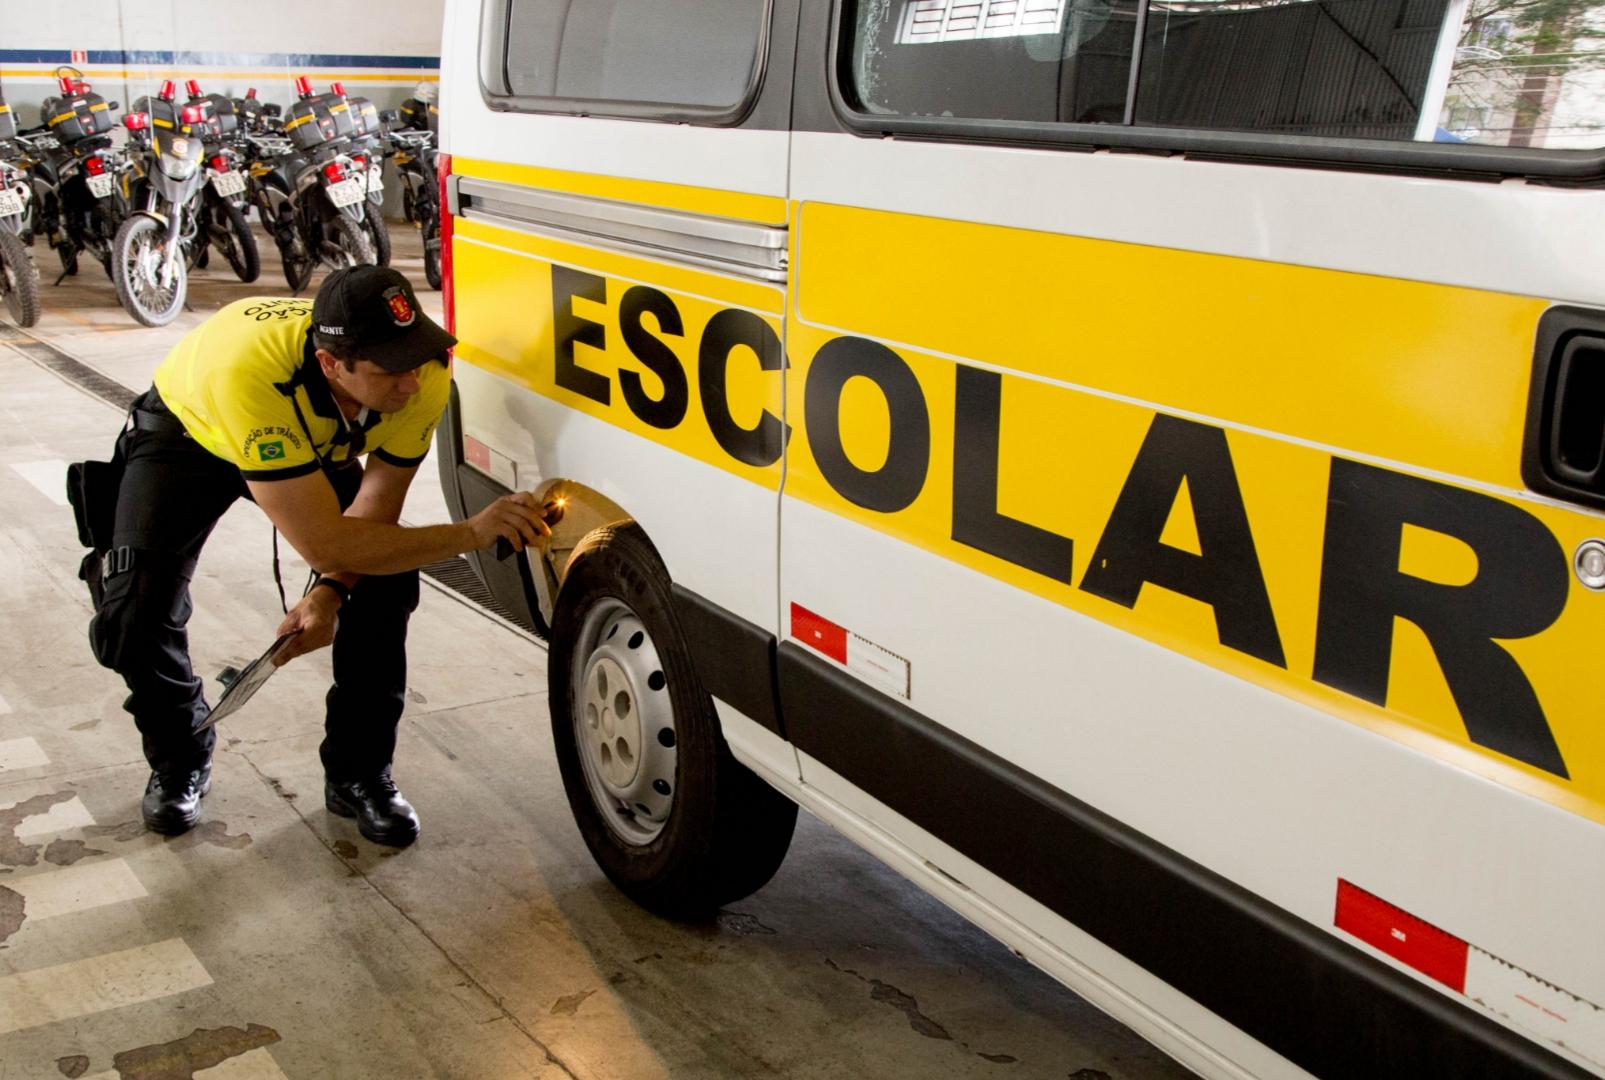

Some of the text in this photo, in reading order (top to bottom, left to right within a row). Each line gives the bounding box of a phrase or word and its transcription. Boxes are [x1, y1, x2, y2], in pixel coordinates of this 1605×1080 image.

[320, 324, 345, 335] AGENTE
[264, 426, 274, 435] DE
[551, 263, 1571, 781] ESCOLAR
